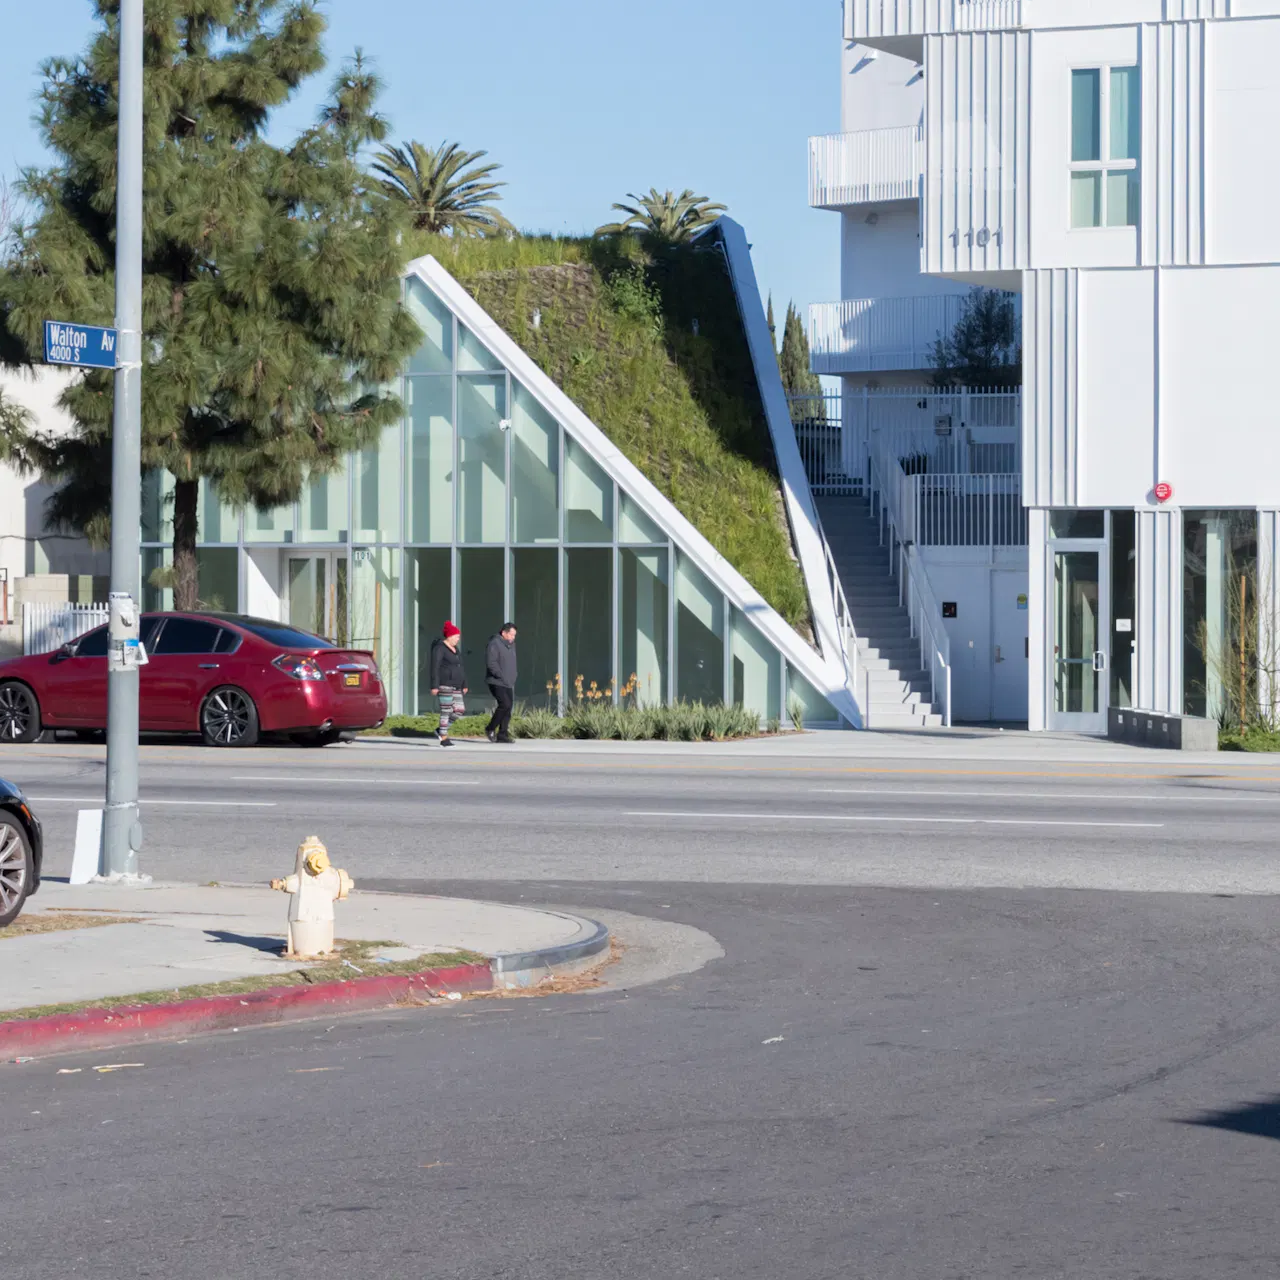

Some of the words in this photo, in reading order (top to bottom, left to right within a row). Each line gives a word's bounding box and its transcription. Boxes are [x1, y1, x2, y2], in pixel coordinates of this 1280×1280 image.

[50, 324, 87, 348] Walton
[101, 331, 115, 351] Av
[50, 346, 71, 360] 4000
[74, 347, 80, 362] S
